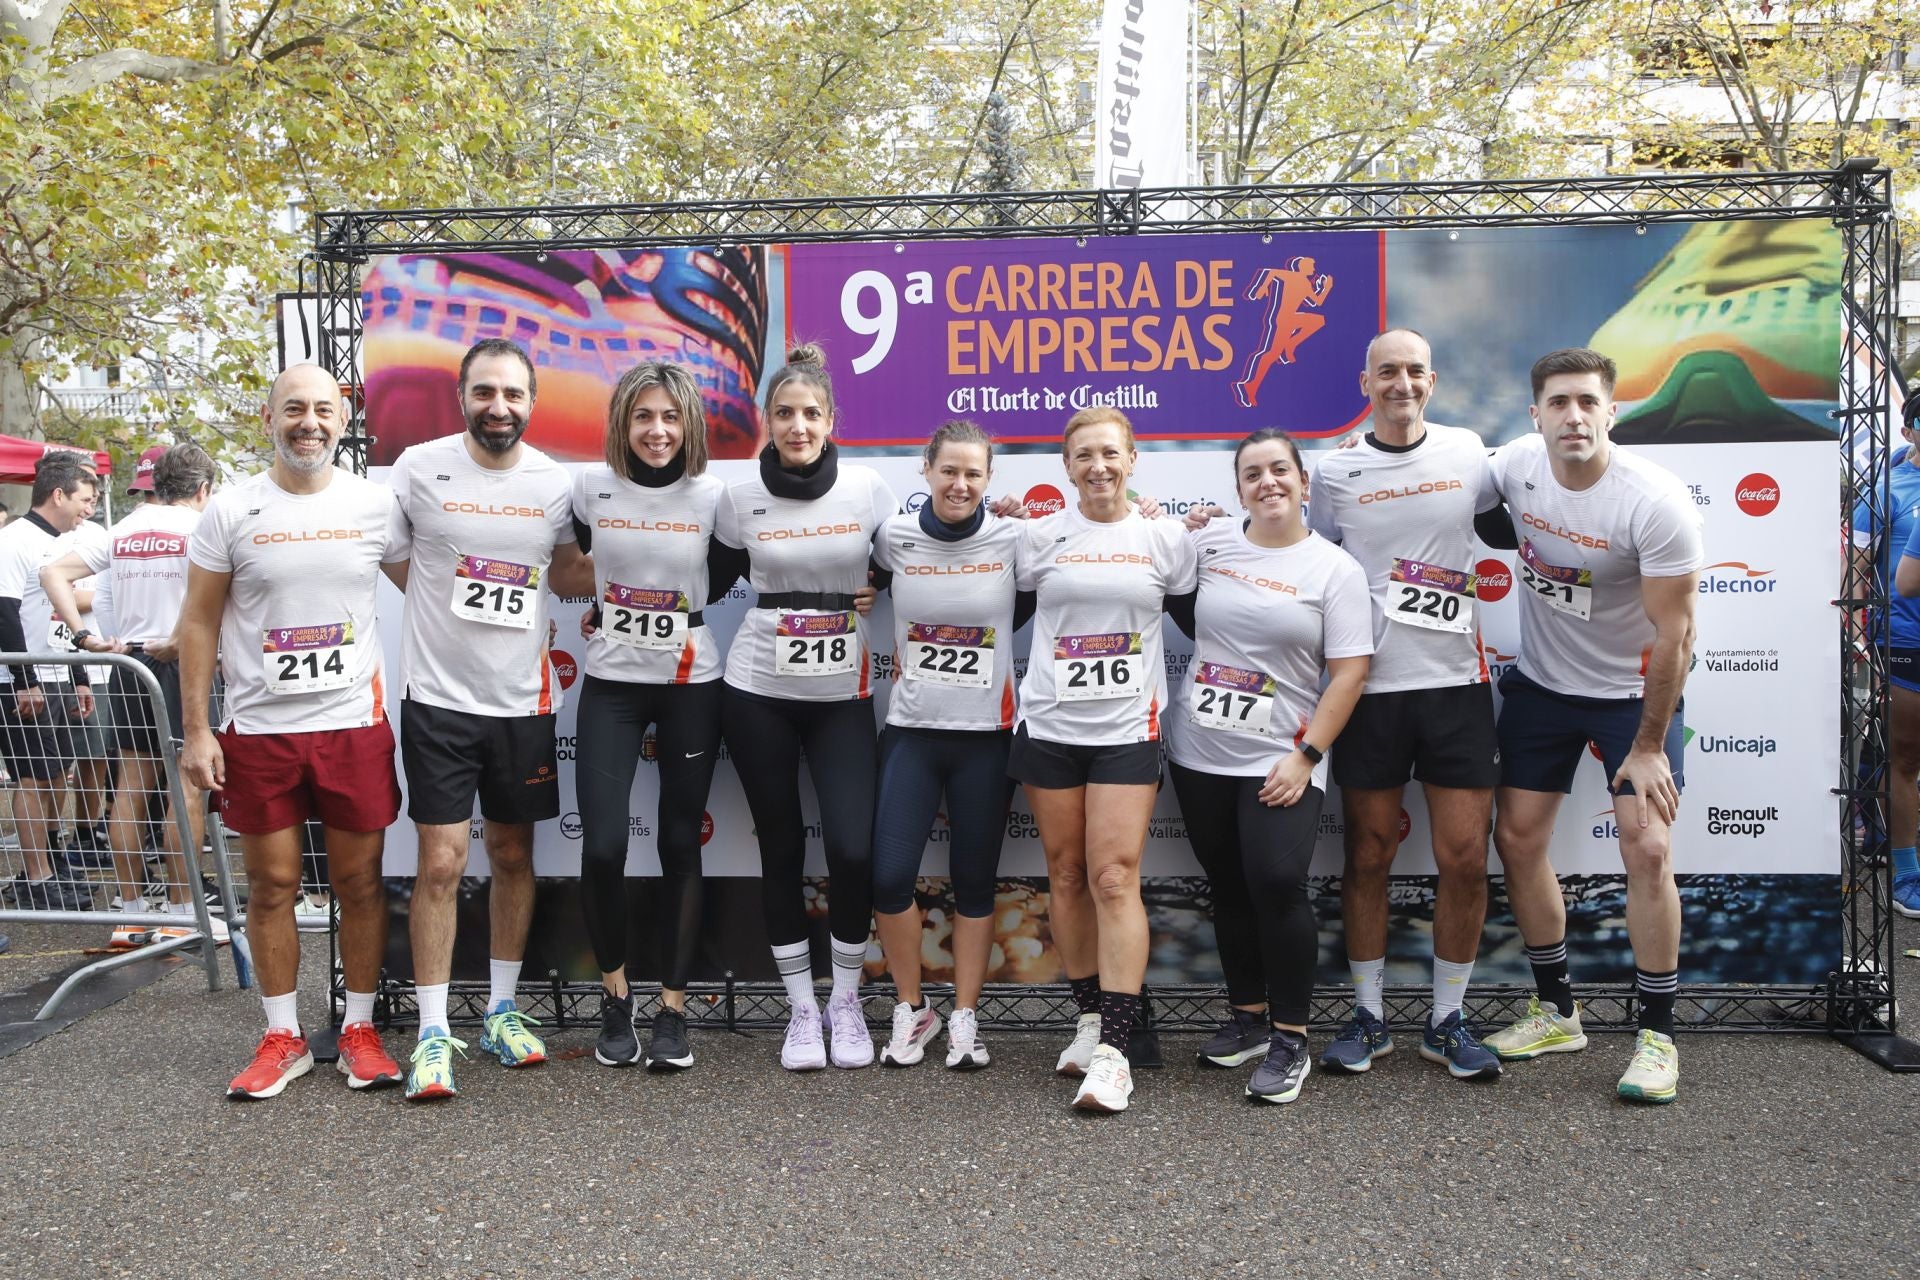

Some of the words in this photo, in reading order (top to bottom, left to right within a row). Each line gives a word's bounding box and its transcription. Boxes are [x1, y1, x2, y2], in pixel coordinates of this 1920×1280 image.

[946, 260, 1159, 313] CARRERA
[1176, 260, 1234, 308] DE
[947, 314, 1234, 375] EMPRESAS
[947, 387, 976, 413] El
[979, 387, 1040, 413] Norte
[1043, 387, 1066, 410] de
[1070, 384, 1160, 410] Castilla
[1358, 480, 1463, 505] COLLOSA
[443, 502, 545, 518] COLLOSA
[597, 519, 700, 533] COLLOSA
[757, 523, 861, 541] COLLOSA
[1521, 512, 1611, 551] COLLOSA
[117, 537, 180, 554] Helios
[253, 529, 364, 545] COLLOSA
[1055, 553, 1153, 566] COLLOSA
[904, 562, 1004, 576] COLLOSA
[1523, 566, 1573, 603] 221
[1698, 576, 1777, 593] elecnor
[464, 582, 525, 615] 215
[1398, 587, 1460, 621] 220
[55, 624, 74, 640] 45
[292, 628, 320, 636] CARRERA
[613, 609, 674, 638] 219
[292, 633, 328, 642] EMPRESAS
[1082, 641, 1115, 650] EMPRESAS
[788, 638, 847, 663] 218
[1706, 649, 1765, 658] Ayuntamiento
[277, 650, 344, 681] 214
[919, 646, 979, 675] 222
[1706, 659, 1779, 672] Valladolid
[1067, 659, 1130, 687] 216
[1197, 688, 1258, 721] 217
[1700, 736, 1777, 757] Unicaja
[1321, 814, 1336, 823] DE
[1708, 806, 1778, 821] Renault
[1008, 825, 1040, 838] Gro
[1707, 821, 1765, 838] Group
